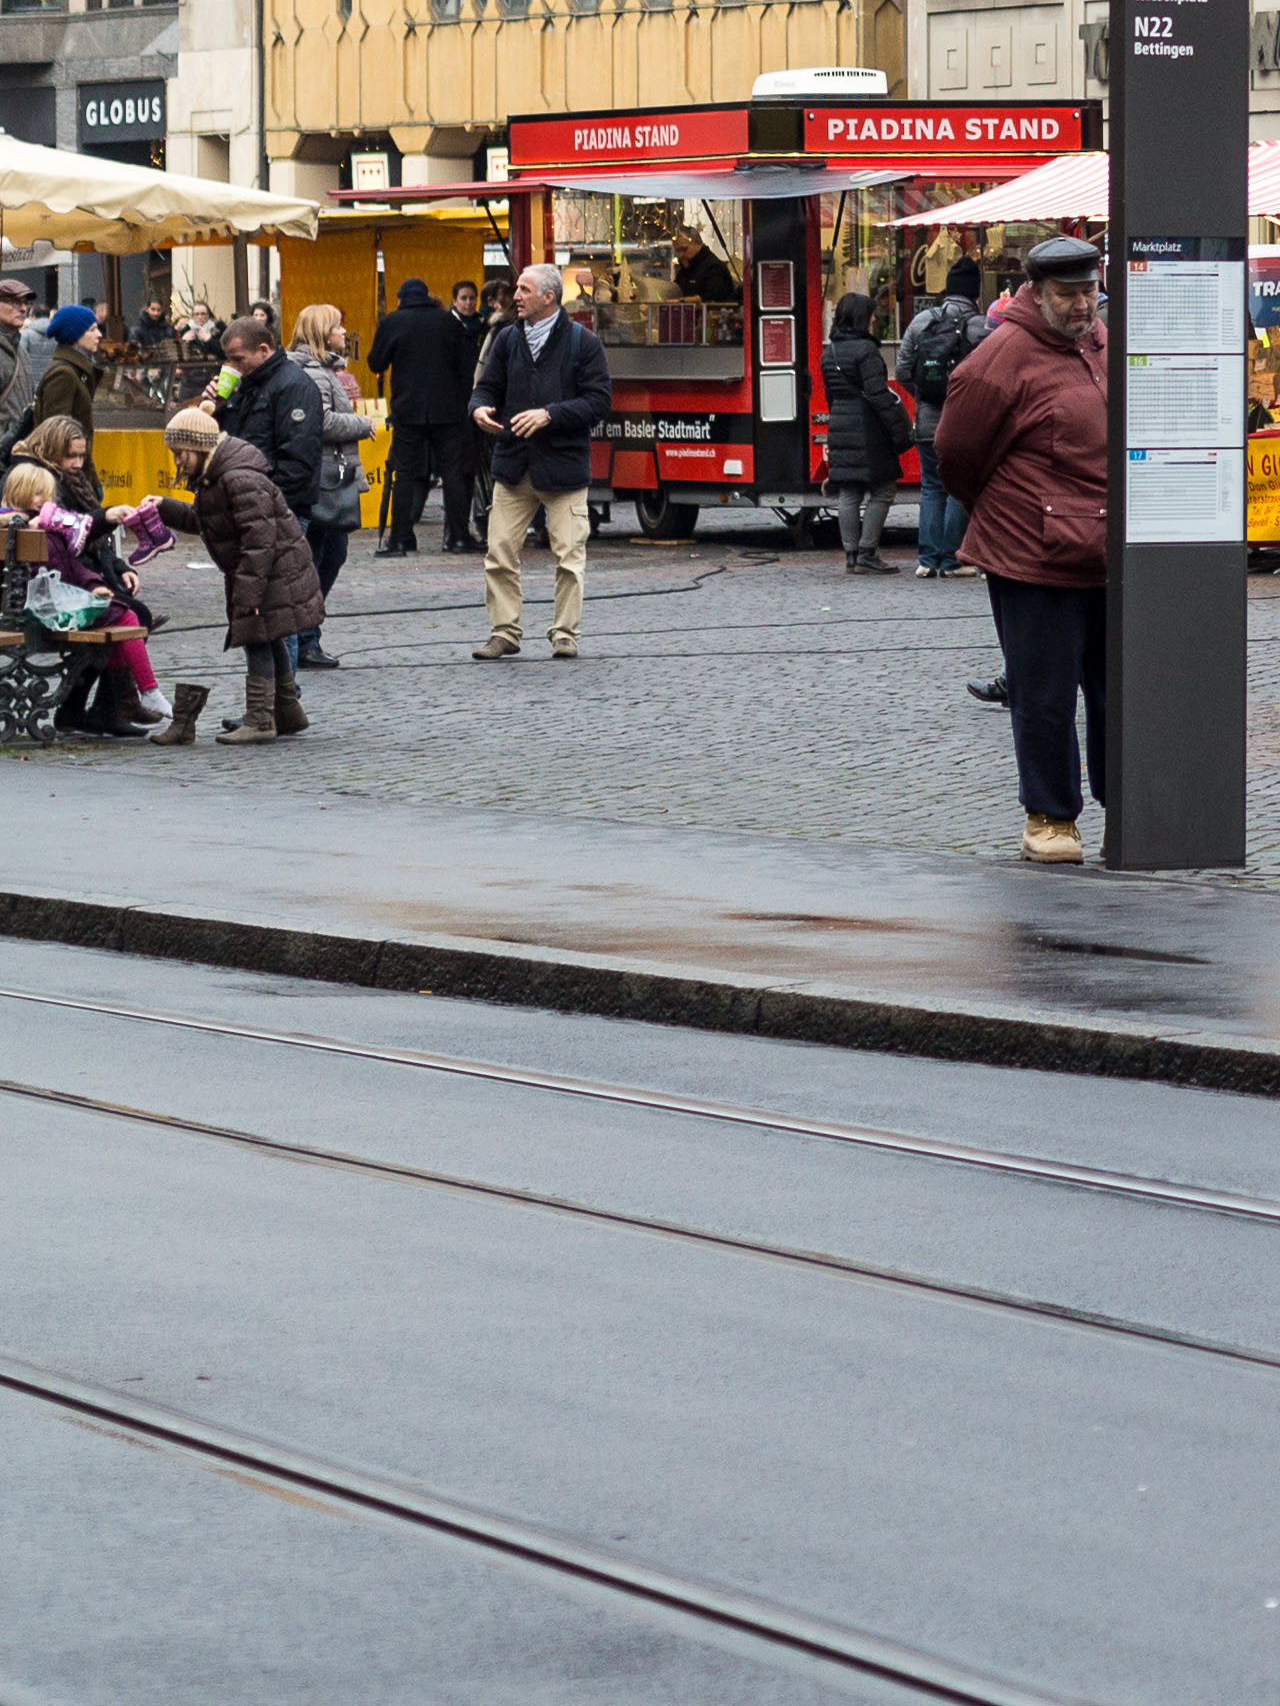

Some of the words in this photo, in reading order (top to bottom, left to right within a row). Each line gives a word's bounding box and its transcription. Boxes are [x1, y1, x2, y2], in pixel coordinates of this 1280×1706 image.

[1134, 16, 1173, 38] N22
[1134, 42, 1194, 59] Bettingen
[86, 97, 161, 126] GLOBUS
[574, 128, 632, 151] PIADINA
[635, 124, 679, 148] STAND
[827, 118, 955, 141] PIADINA
[964, 118, 1060, 141] STAND
[1132, 242, 1182, 254] Marktplatz
[1134, 262, 1145, 271] 14
[606, 422, 622, 437] em
[624, 420, 656, 439] Basler
